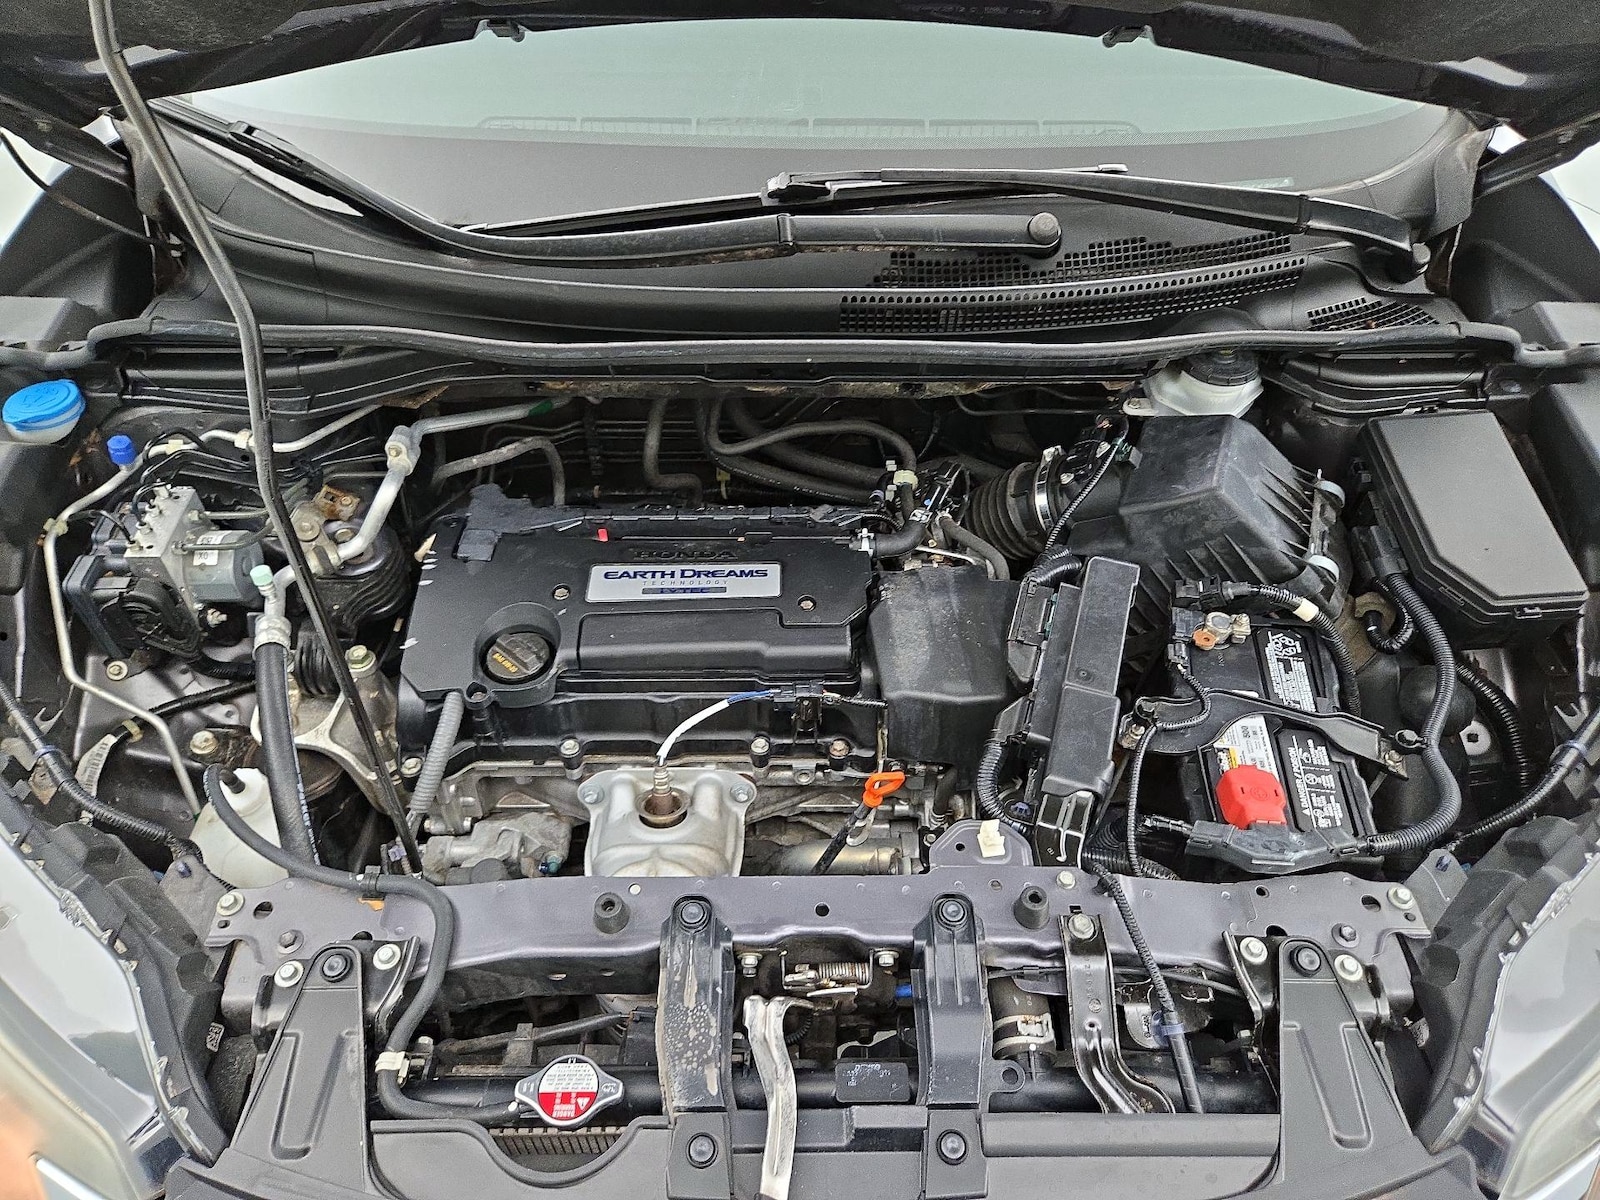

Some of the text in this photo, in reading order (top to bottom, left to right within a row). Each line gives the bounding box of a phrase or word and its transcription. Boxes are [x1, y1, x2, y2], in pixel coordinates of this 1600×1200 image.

[634, 551, 739, 561] HONDA
[604, 568, 769, 580] EARTH DREAMS
